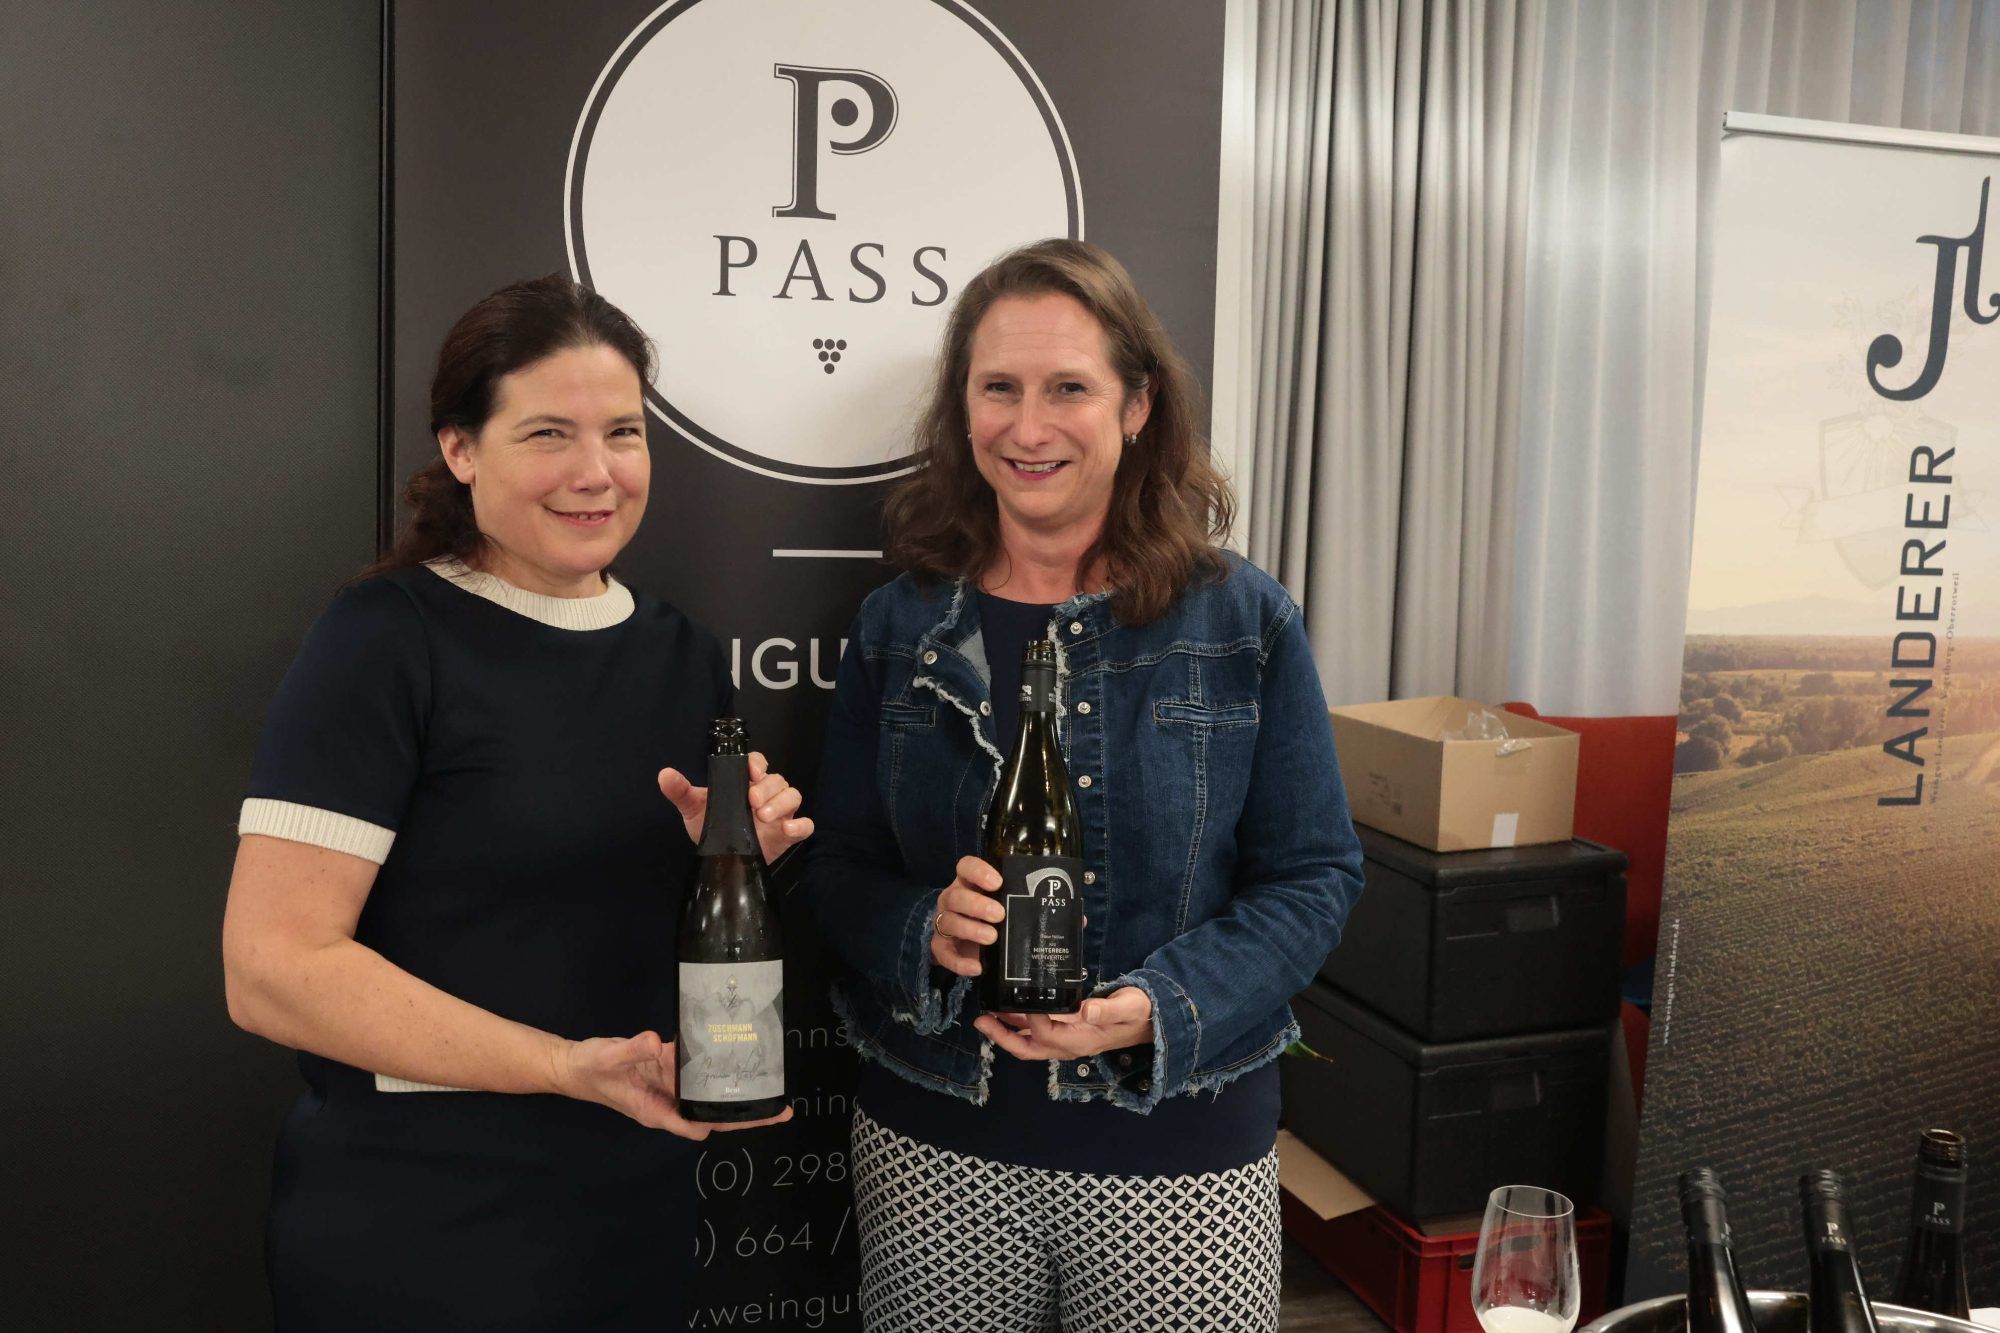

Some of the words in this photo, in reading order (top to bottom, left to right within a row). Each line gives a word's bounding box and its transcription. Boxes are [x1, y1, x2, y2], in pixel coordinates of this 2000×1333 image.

[771, 63, 899, 221] P
[712, 235, 949, 307] PASS
[1877, 445, 1956, 807] LANDERER
[1041, 897, 1066, 907] PASS
[1047, 879, 1062, 898] P
[708, 1023, 753, 1033] ZUSCHMANN
[773, 1152, 846, 1187] 298
[735, 1221, 813, 1258] 664
